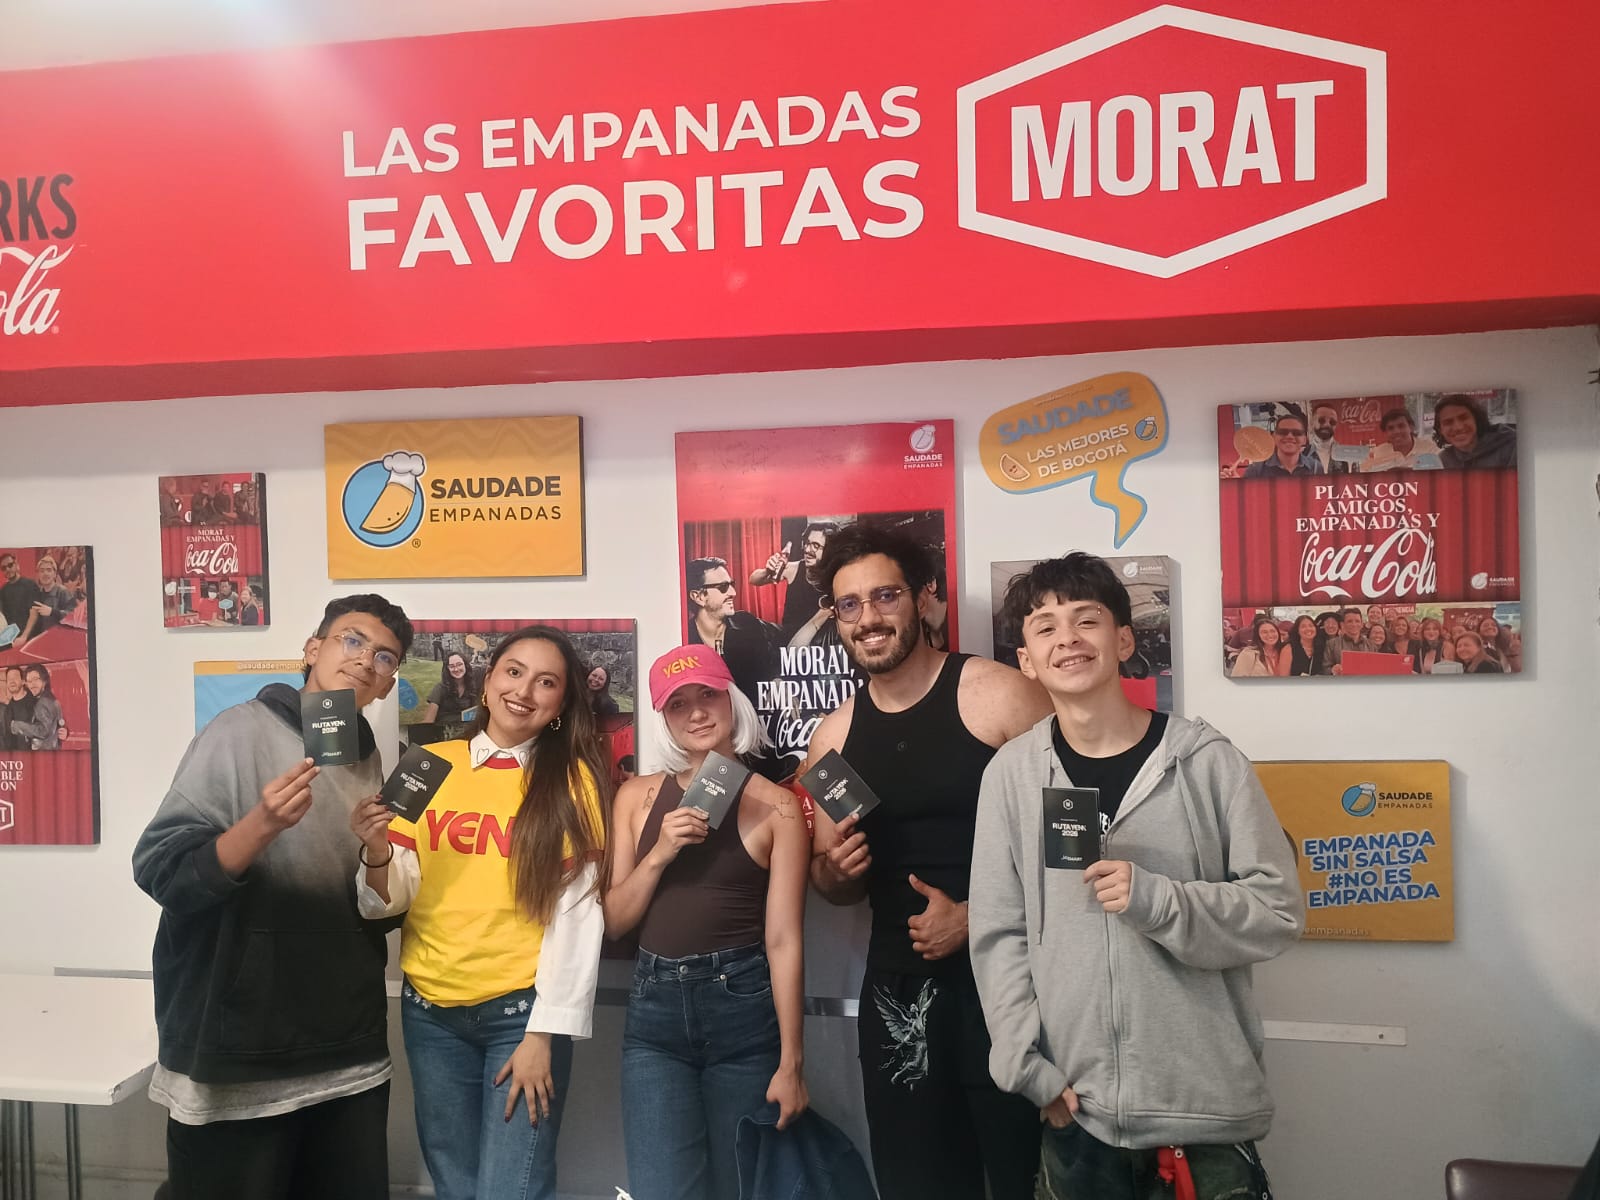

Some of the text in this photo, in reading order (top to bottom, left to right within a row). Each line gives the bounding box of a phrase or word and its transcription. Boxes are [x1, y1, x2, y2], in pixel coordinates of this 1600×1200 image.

[342, 86, 921, 177] LAS EMPANADAS
[1010, 79, 1335, 202] MORAT
[347, 160, 925, 271] FAVORITAS
[997, 387, 1135, 445] SAUDADE
[1027, 424, 1130, 463] LAS MEJORES
[904, 454, 943, 462] SAUDADE
[1037, 440, 1128, 478] DE BOGOTÁ
[430, 476, 562, 499] SAUDADE
[1315, 481, 1419, 500] PLAN CON
[430, 505, 562, 523] EMPANADAS
[1323, 498, 1413, 516] AMIGOS,
[1296, 512, 1441, 532] EMPANADAS Y
[185, 543, 239, 574] Coca-Cola
[1300, 527, 1437, 598] Coca-Cola
[757, 679, 863, 710] EMPANAD
[0, 781, 17, 791] ON
[1, 771, 23, 780] BLE
[1378, 792, 1433, 800] SAUDADE
[1052, 822, 1071, 831] RUTA
[1304, 831, 1436, 856] EMPANADA
[1312, 849, 1428, 871] SIN SALSA
[1328, 868, 1412, 889] #NO ES
[1308, 883, 1440, 908] EMPANADA
